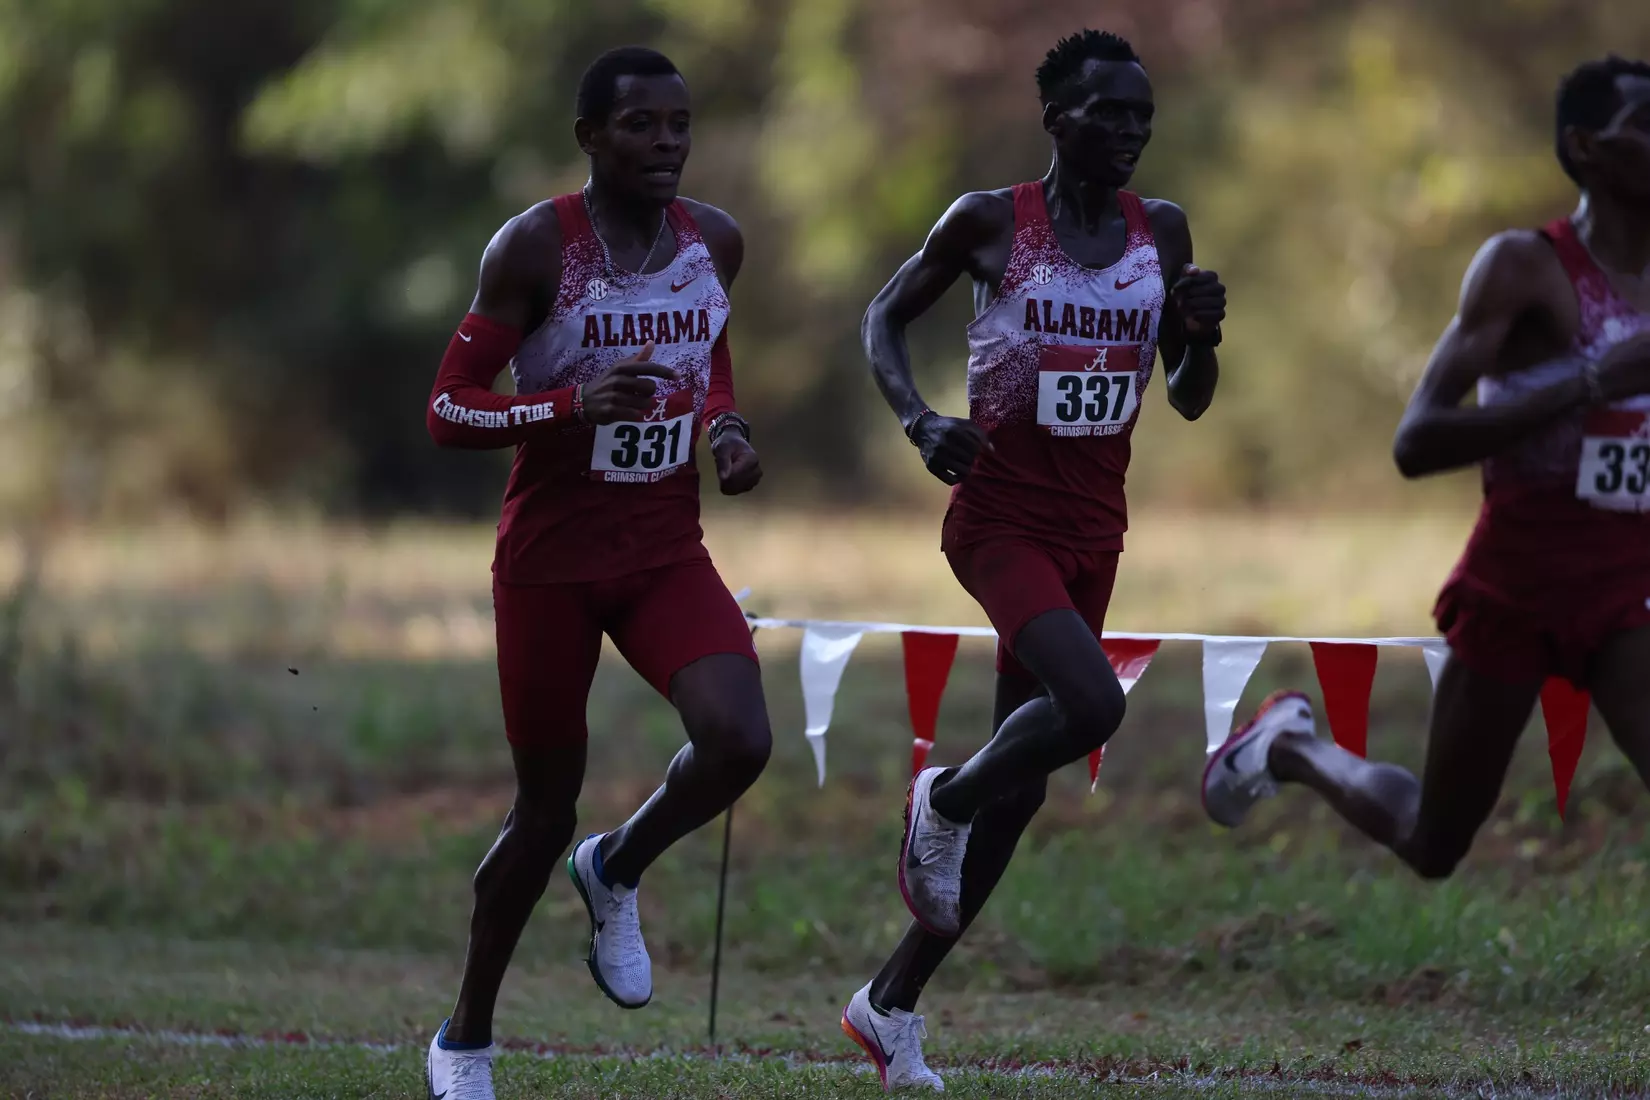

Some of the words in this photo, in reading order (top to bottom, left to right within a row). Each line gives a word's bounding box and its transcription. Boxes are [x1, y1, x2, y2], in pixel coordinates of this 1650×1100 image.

[587, 279, 609, 300] SEC
[1031, 264, 1053, 285] SEC
[581, 309, 710, 348] ALABAMA
[1024, 298, 1150, 342] ALABAMA
[1084, 347, 1108, 371] A
[433, 392, 509, 428] CRIMSON
[510, 401, 555, 425] TIDE
[643, 398, 668, 422] A
[1056, 375, 1130, 422] 337
[610, 420, 682, 469] 331
[1050, 425, 1092, 437] CRIMSON
[604, 471, 649, 483] CRIMSON
[1596, 443, 1650, 494] 33
